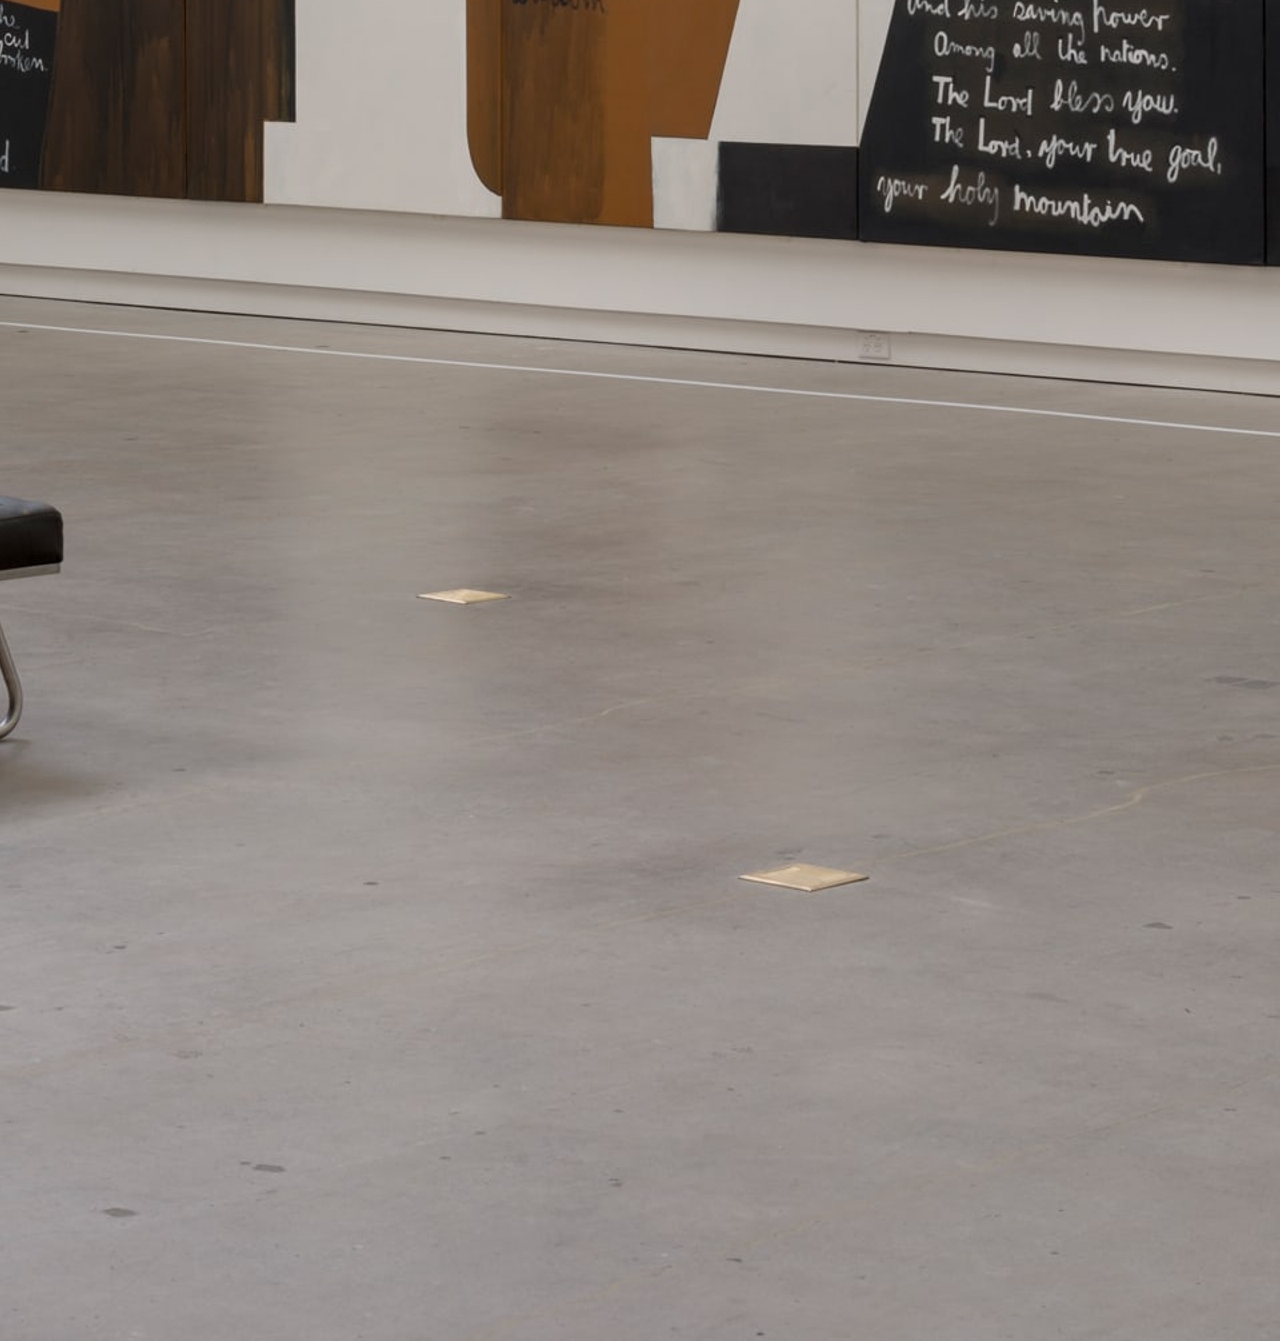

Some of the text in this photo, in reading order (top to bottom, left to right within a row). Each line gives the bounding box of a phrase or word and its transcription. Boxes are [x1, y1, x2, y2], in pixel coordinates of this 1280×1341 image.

[4, 28, 30, 50] cut
[934, 30, 1177, 72] Among all the nations.
[932, 75, 1178, 124] The Lord bless you.
[931, 117, 964, 147] The
[1038, 134, 1097, 169] your
[1107, 128, 1153, 171] true
[877, 164, 1144, 228] your holy mountain
